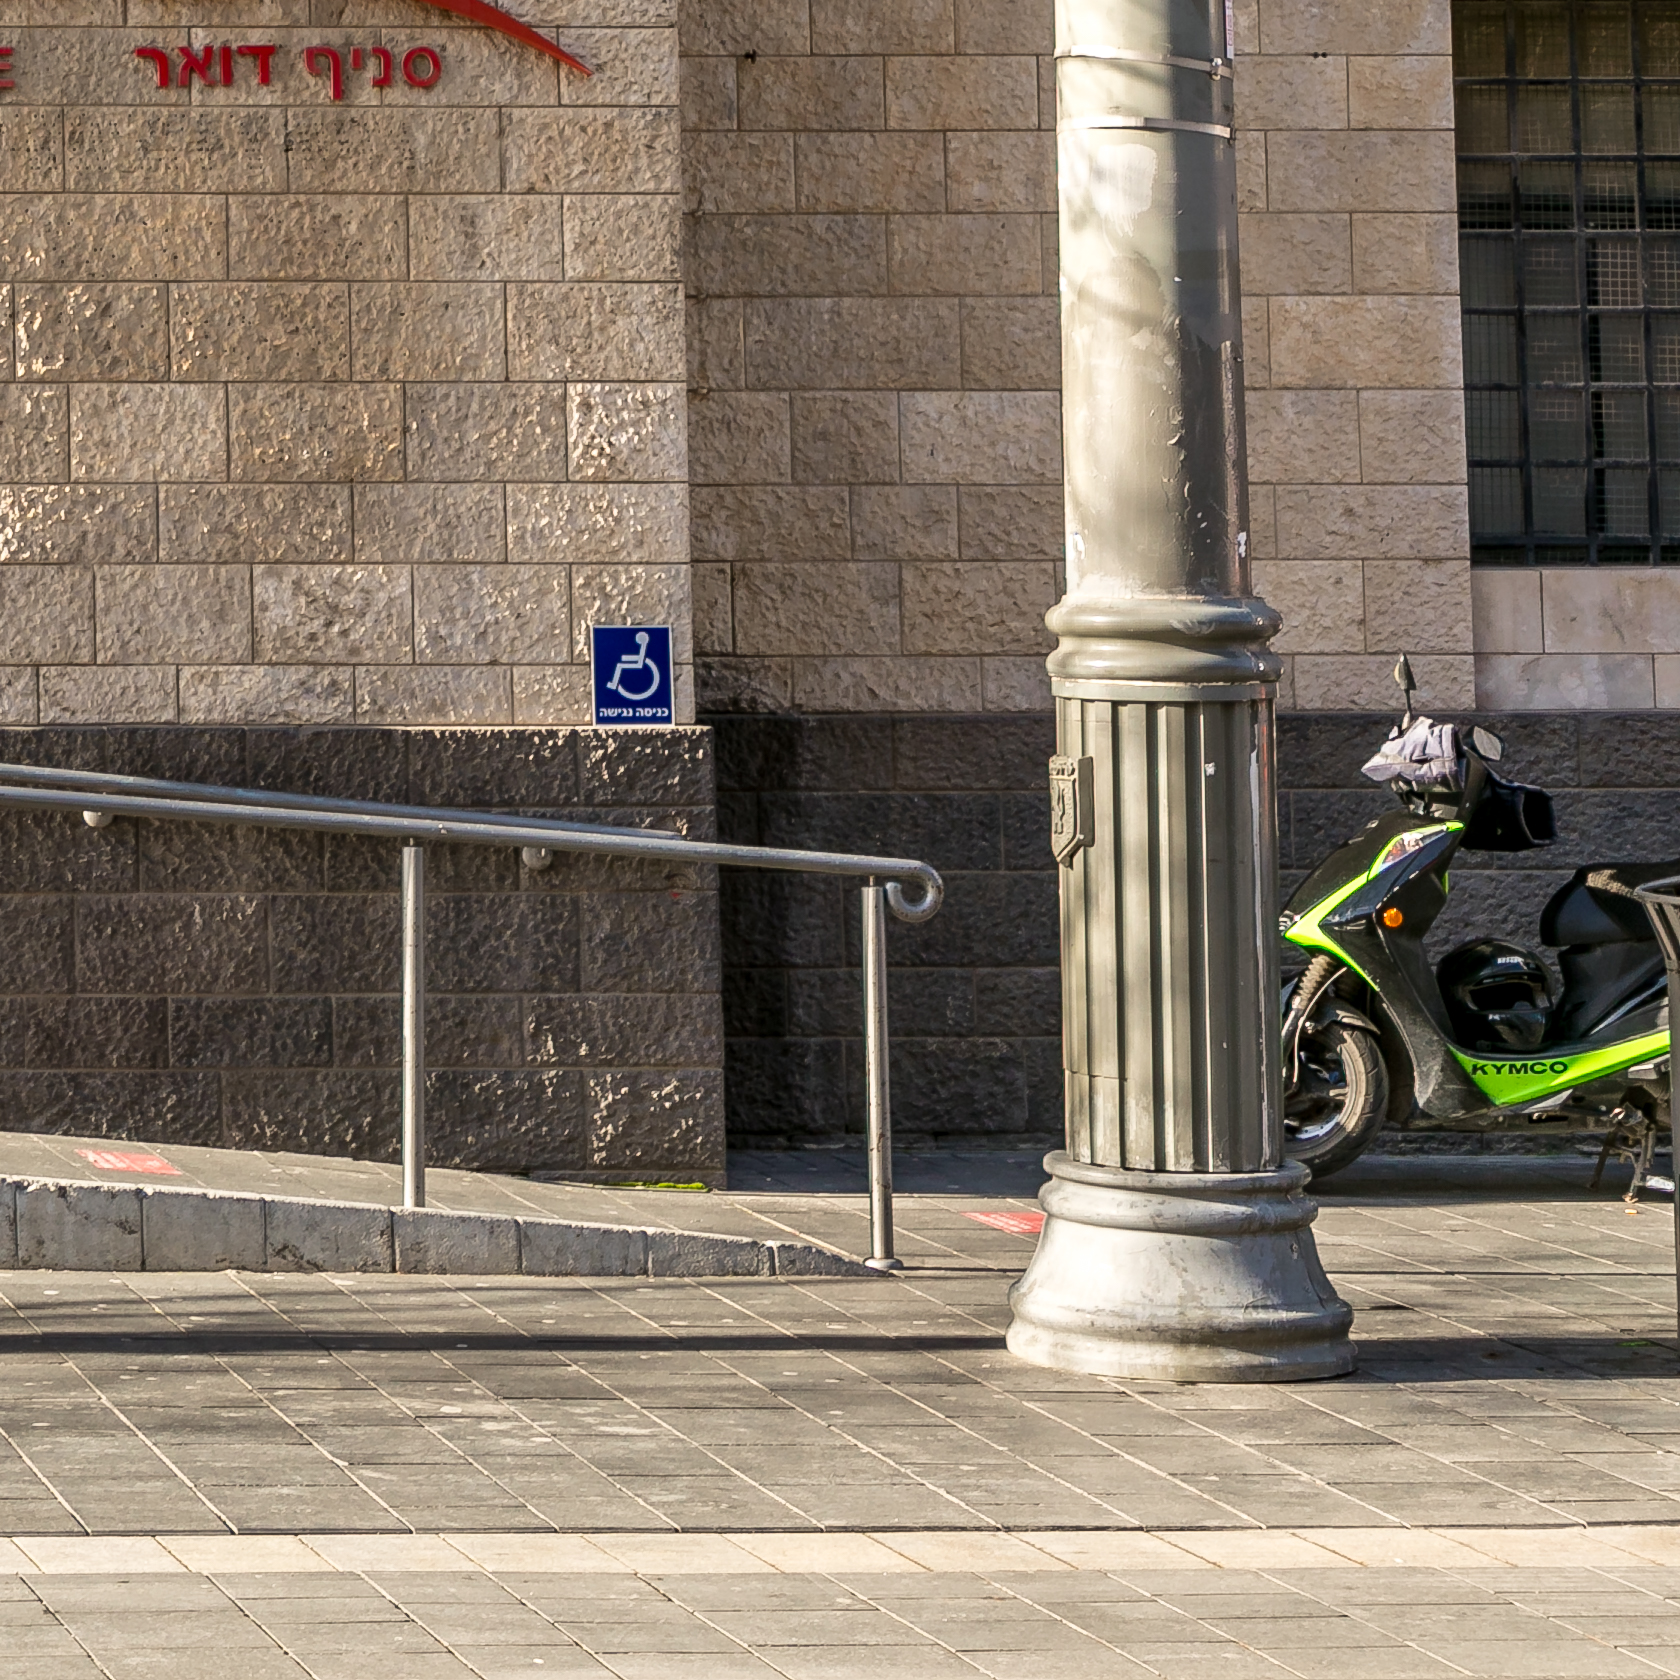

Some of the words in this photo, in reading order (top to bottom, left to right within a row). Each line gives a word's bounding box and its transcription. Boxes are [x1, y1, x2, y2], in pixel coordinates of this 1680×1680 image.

[135, 45, 276, 88] דואר
[303, 45, 443, 101] סניף
[599, 707, 633, 717] נגישה
[635, 707, 669, 717] כניסה
[1471, 1061, 1568, 1076] KYMCO
